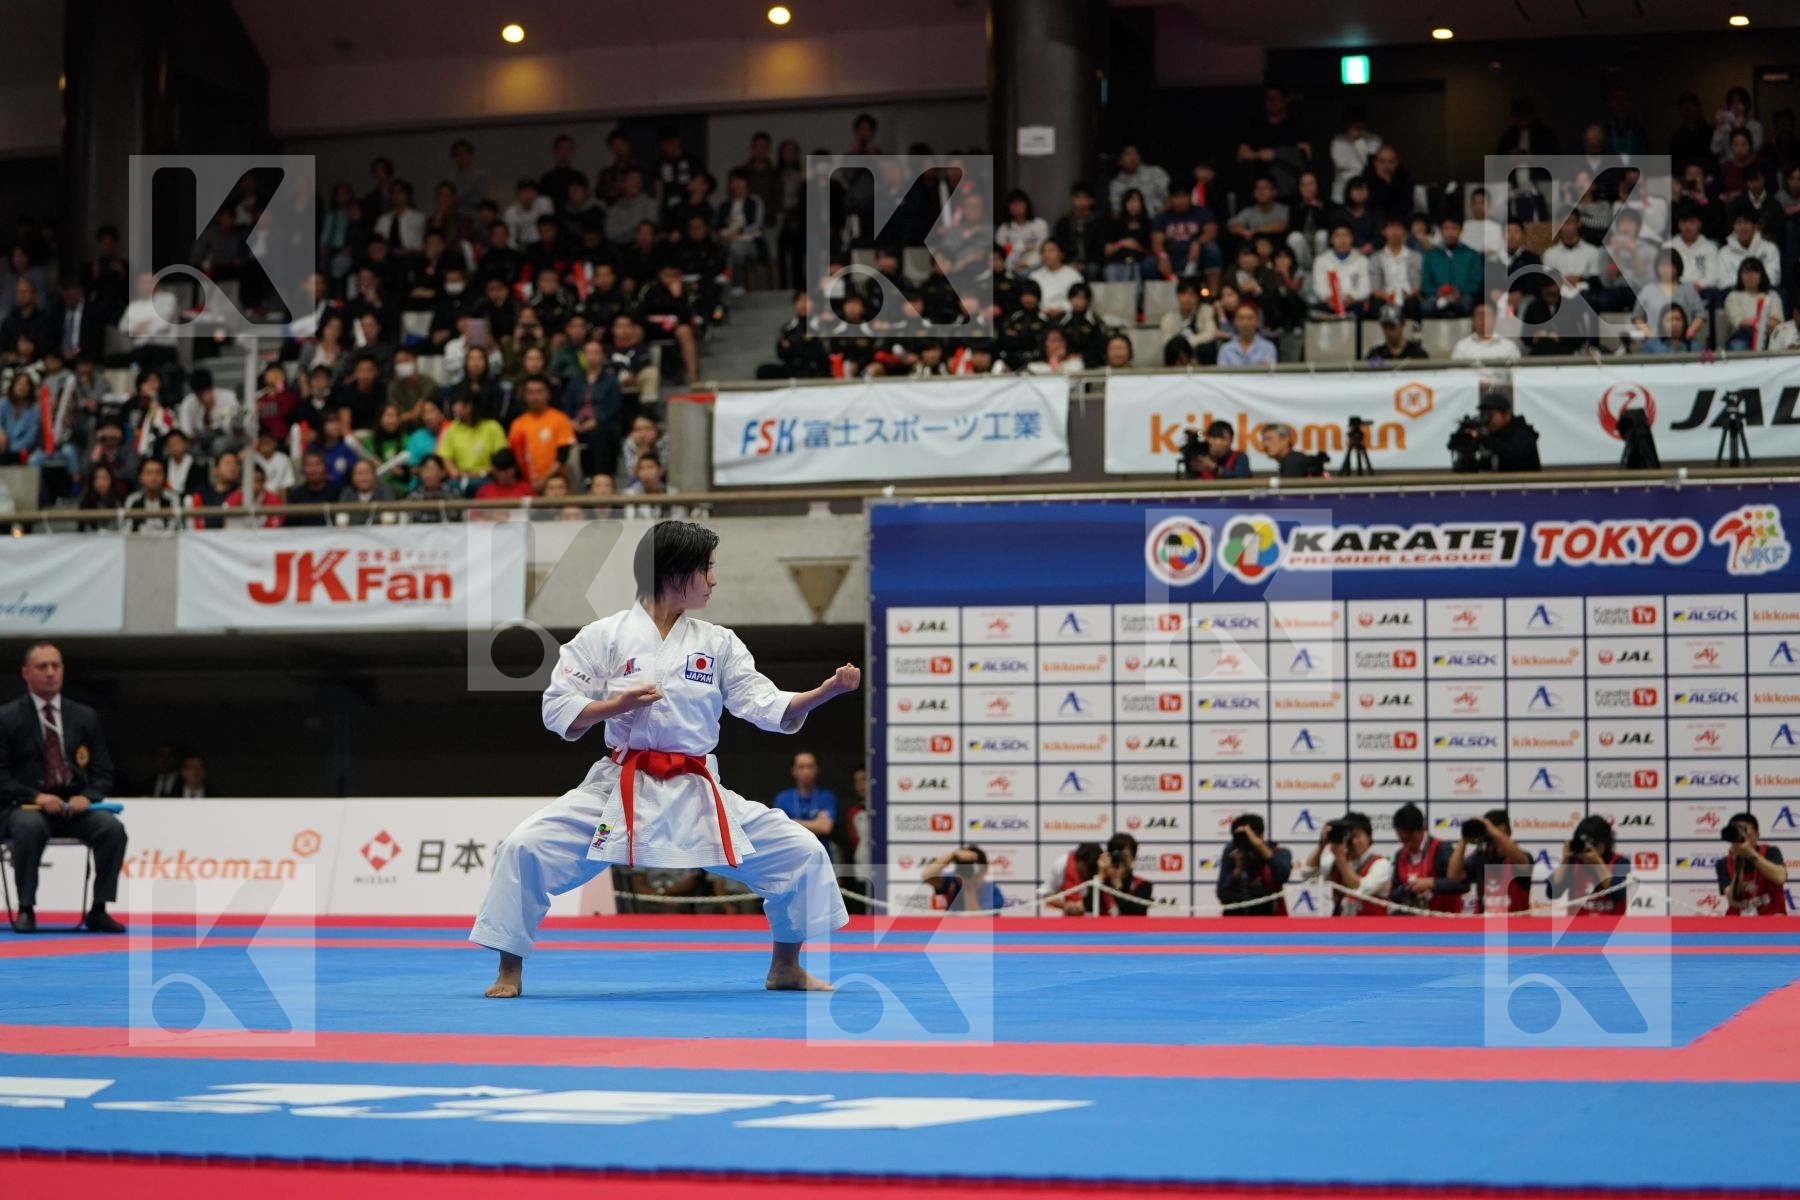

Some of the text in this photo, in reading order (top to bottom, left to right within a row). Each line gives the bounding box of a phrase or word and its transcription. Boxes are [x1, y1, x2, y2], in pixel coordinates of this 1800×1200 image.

[741, 411, 1041, 456] FSK 富士スポーツ工業
[1537, 524, 1698, 560] TOKYO
[1288, 552, 1493, 566] PREMIER LEAGUE
[246, 549, 453, 605] JK Fan
[1377, 612, 1413, 625] JAL
[1687, 610, 1737, 622] ALSOK
[1143, 655, 1179, 668] JAL
[1447, 654, 1496, 666] ALSOK
[1616, 650, 1653, 663] JAL
[572, 671, 592, 684] JAL
[686, 672, 712, 684] JAPAN
[1377, 693, 1414, 706] JAL
[1688, 692, 1738, 704] ALSOK
[1144, 735, 1179, 748] JAL
[1448, 735, 1497, 747] ALSOK
[1616, 731, 1654, 744] JAL
[1378, 774, 1414, 786] JAL
[1689, 774, 1739, 786] ALSOK
[1144, 815, 1180, 828] JAL
[1617, 813, 1655, 826] JAL
[416, 838, 503, 874] 日本
[1690, 857, 1721, 868] ALS
[1631, 896, 1657, 908] AL
